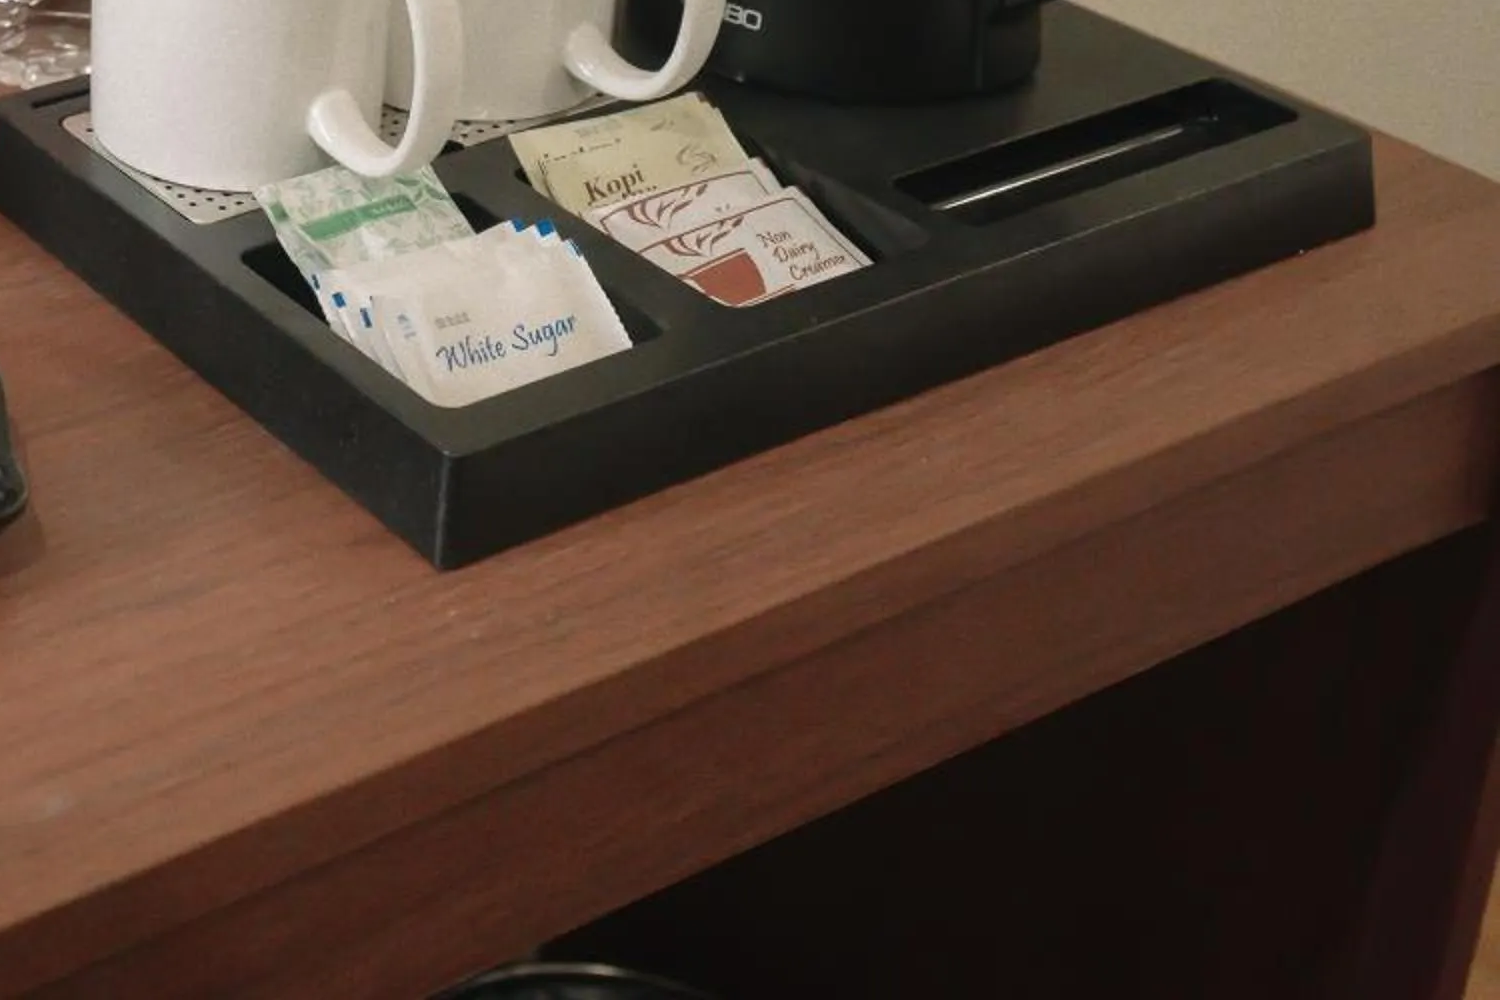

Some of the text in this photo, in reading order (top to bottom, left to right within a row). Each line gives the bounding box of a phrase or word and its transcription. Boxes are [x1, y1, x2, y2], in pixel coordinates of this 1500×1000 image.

[584, 163, 645, 203] Kopi
[756, 231, 792, 249] Non
[436, 335, 507, 372] White
[512, 315, 576, 357] Sugar
